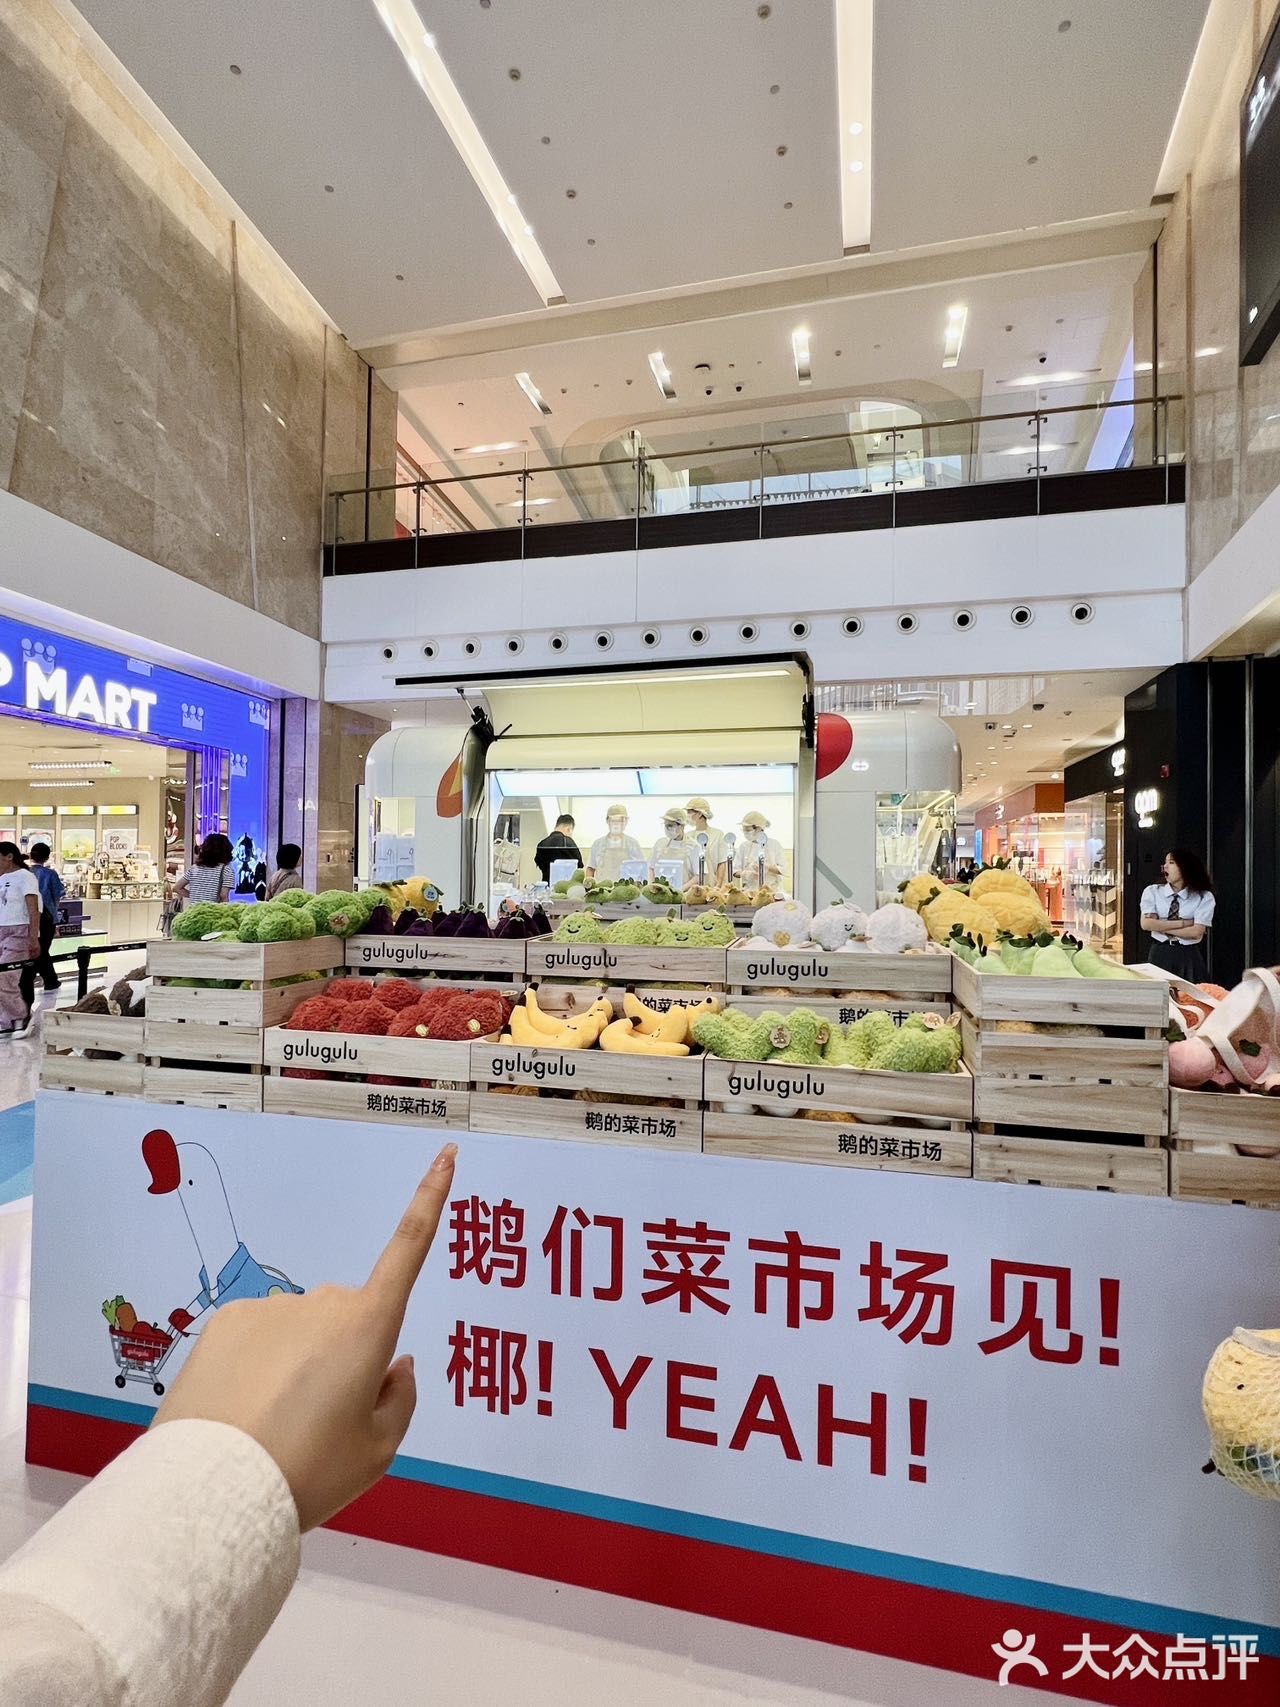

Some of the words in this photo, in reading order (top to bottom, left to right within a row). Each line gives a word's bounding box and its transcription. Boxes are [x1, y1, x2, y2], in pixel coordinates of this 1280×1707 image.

[25, 660, 158, 734] MART
[362, 941, 429, 963] gulugulu
[545, 947, 618, 970] gulugulu
[746, 957, 829, 981] gulugulu
[283, 1038, 358, 1064] gulugulu
[491, 1052, 577, 1080] gulugulu
[727, 1069, 826, 1099] gulugulu
[366, 1093, 448, 1118] 鹅的菜市场
[585, 1111, 677, 1138] 鹅的菜市场
[837, 1133, 943, 1162] 鹅的菜市场
[446, 1319, 554, 1417] 椰!
[588, 1347, 928, 1484] YEAH!
